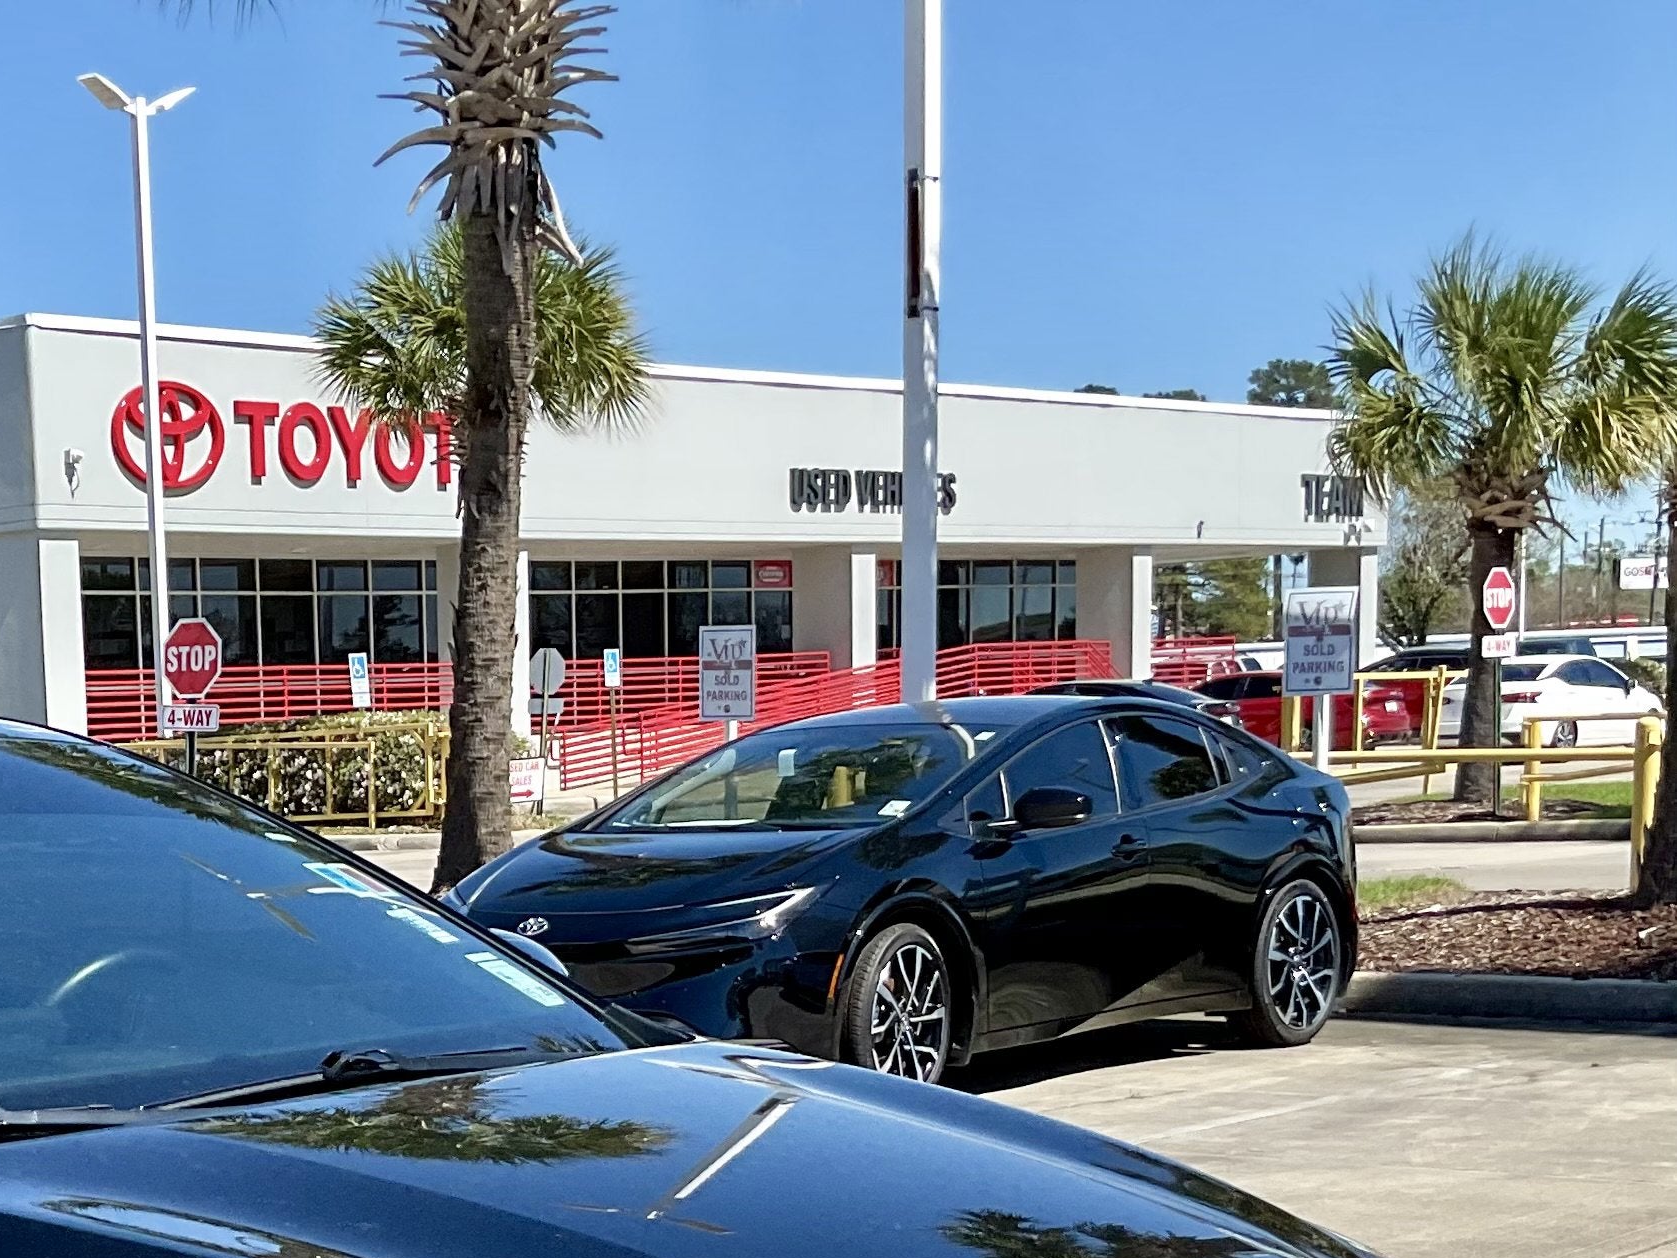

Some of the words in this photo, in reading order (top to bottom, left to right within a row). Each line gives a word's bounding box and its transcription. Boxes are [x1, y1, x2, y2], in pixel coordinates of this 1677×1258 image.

[234, 400, 454, 491] TOYOT
[789, 468, 851, 512] USED
[1300, 474, 1364, 522] TEAM
[1486, 587, 1512, 608] STOP
[1303, 643, 1336, 657] SOLD
[1486, 640, 1511, 652] 4-WAY
[166, 645, 217, 673] STOP
[1292, 660, 1345, 674] PARKING
[714, 674, 740, 686] SOLD
[706, 690, 747, 702] PARKING
[167, 709, 213, 727] 4-WAY
[510, 762, 524, 772] SED
